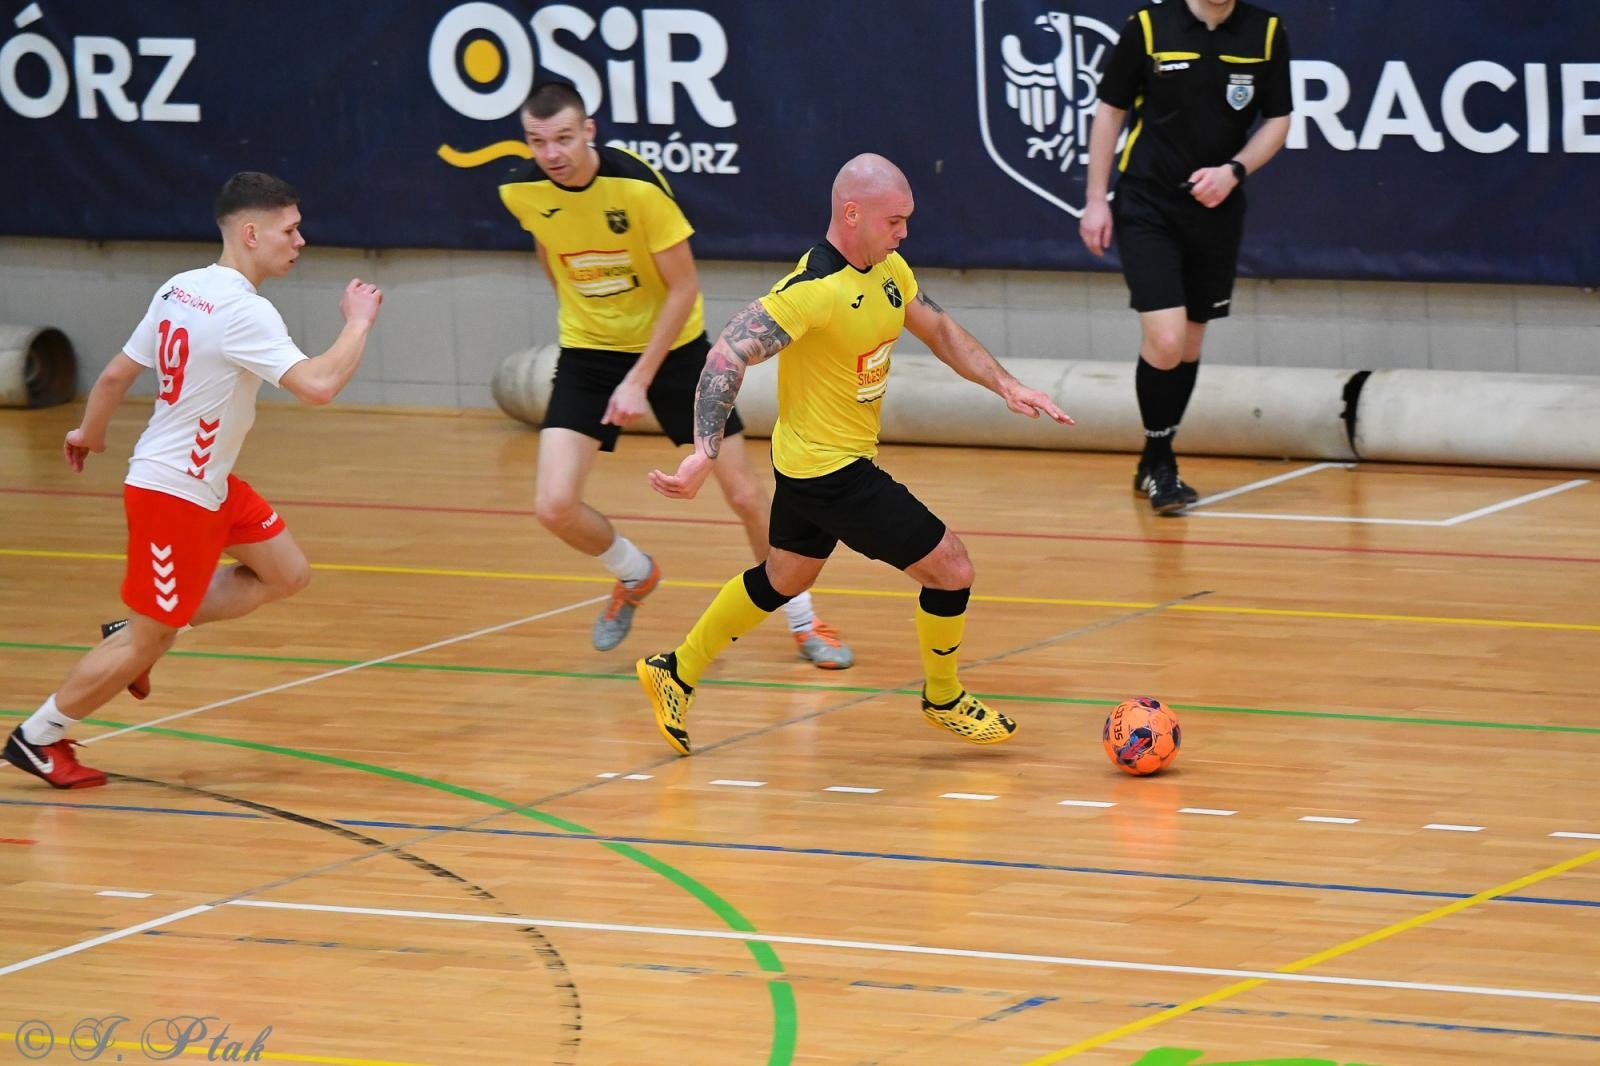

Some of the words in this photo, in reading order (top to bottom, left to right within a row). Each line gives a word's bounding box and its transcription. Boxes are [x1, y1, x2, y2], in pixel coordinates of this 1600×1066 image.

[0, 2, 202, 123] ÓRZ
[428, 1, 738, 129] OSiR
[604, 131, 740, 175] BÓRZ
[157, 319, 190, 407] 19
